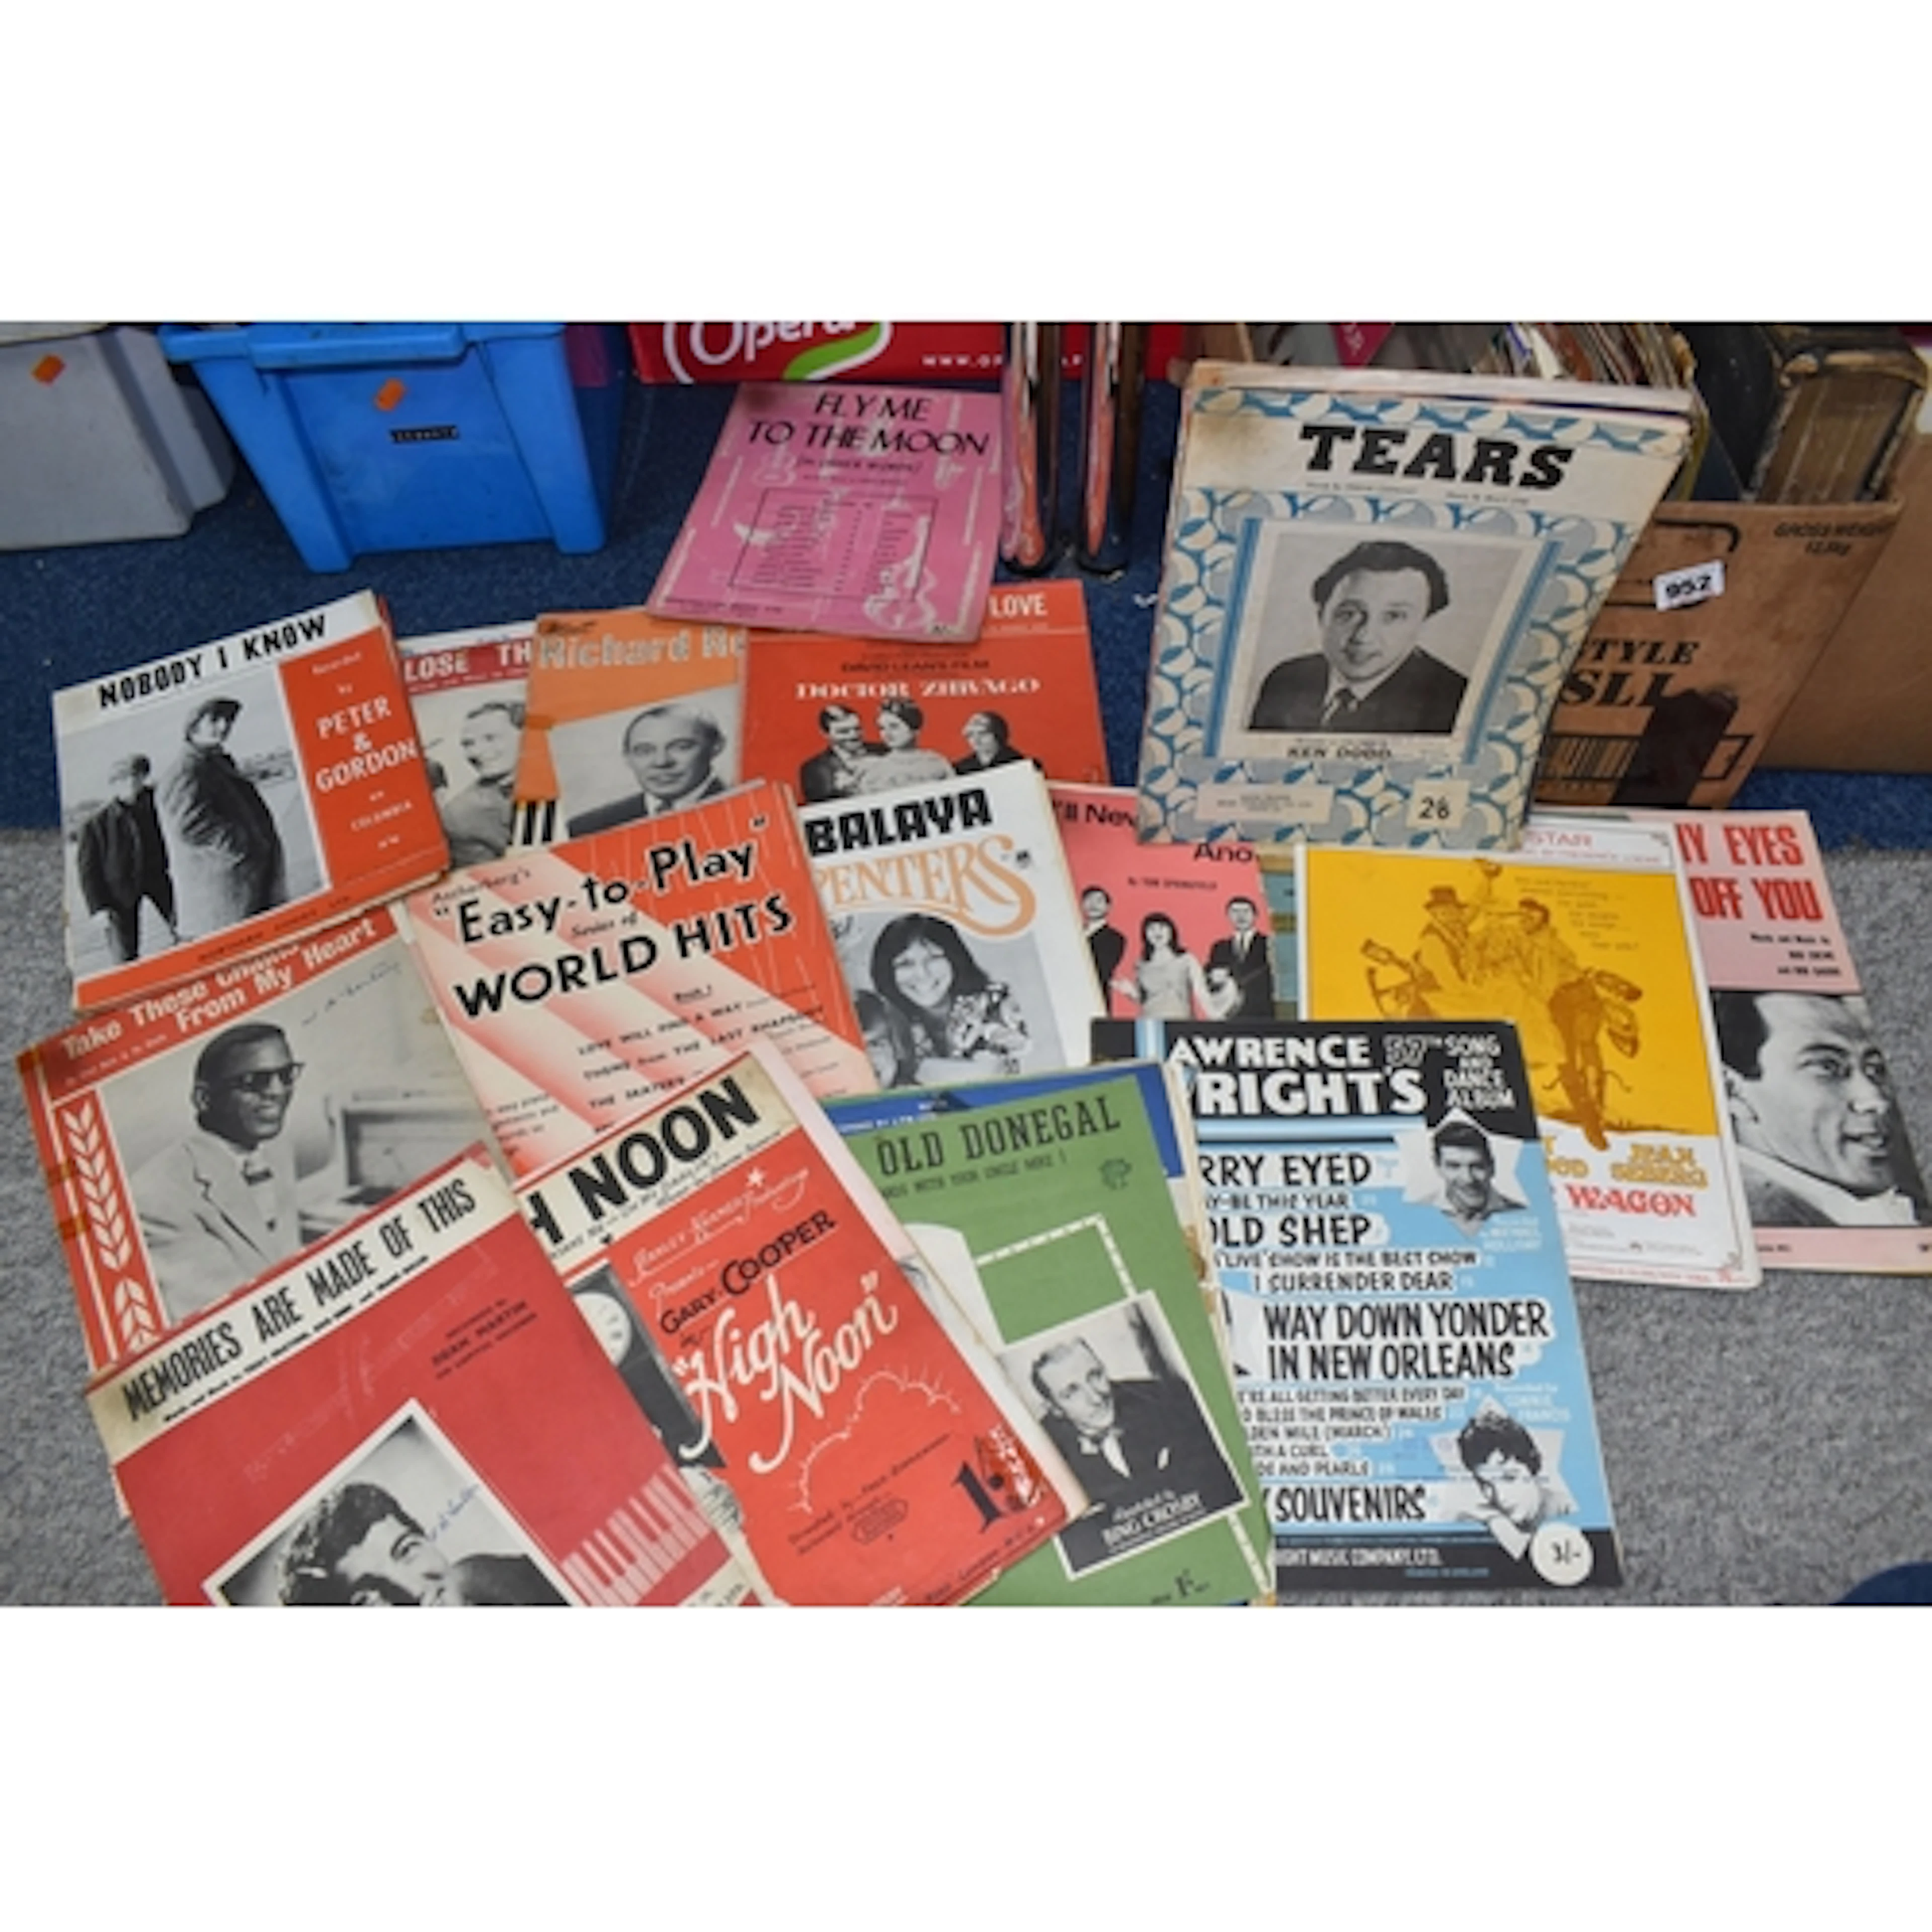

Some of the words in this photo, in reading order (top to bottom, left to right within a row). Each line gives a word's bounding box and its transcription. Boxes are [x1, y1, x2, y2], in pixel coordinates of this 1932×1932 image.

[814, 391, 875, 417] FLY
[877, 396, 933, 422] ME
[748, 420, 795, 445] TO
[804, 423, 866, 450] THE
[870, 428, 990, 456] MOON
[1299, 424, 1575, 490] TEARS
[990, 594, 1047, 617] LOVE
[99, 654, 202, 708] NOBODY
[219, 649, 228, 669] I
[244, 615, 326, 660] KNOW
[404, 650, 470, 681] LOSE
[538, 628, 691, 669] Richard
[795, 679, 910, 699] DOCTOR
[316, 695, 391, 739] PETER
[353, 731, 373, 752] &
[315, 738, 419, 793] GORDON
[806, 788, 993, 856] BALAYA
[1723, 824, 1803, 865] EYES
[1689, 877, 1742, 920] OFF
[1750, 878, 1823, 921] YOU
[176, 987, 247, 1033] From
[254, 964, 292, 995] My
[301, 917, 377, 970] Heart
[453, 935, 658, 1018] WORLD
[673, 893, 793, 958] HITS
[61, 1019, 122, 1060] Take
[128, 979, 209, 1027] These
[1170, 1036, 1371, 1068] AWRENCE
[1195, 1066, 1428, 1115] RIGHT'S
[569, 1077, 761, 1221] NOON
[877, 1132, 945, 1176] OLD
[960, 1096, 1120, 1161] DONEGAL
[1283, 1155, 1372, 1185] EYED
[1565, 1183, 1697, 1218] WAGON
[1279, 1215, 1372, 1247] SHEP
[661, 1292, 717, 1334] GARY
[722, 1210, 835, 1295] COOPER
[1268, 1272, 1394, 1294] SURRENDER
[1400, 1271, 1454, 1292] DEAR
[119, 1321, 244, 1423] MEMORIES
[251, 1285, 304, 1347] ARE
[305, 1239, 376, 1307] MADE
[379, 1215, 415, 1258] OF
[418, 1177, 477, 1235] THIS
[1263, 1304, 1331, 1340] WAY
[1336, 1303, 1422, 1340] DOWN
[1431, 1302, 1549, 1338] YONDER
[1268, 1346, 1299, 1382] IN
[1309, 1345, 1374, 1380] NEW
[1381, 1342, 1515, 1379] ORLEANS
[1274, 1485, 1426, 1522] SOUVENIRS
